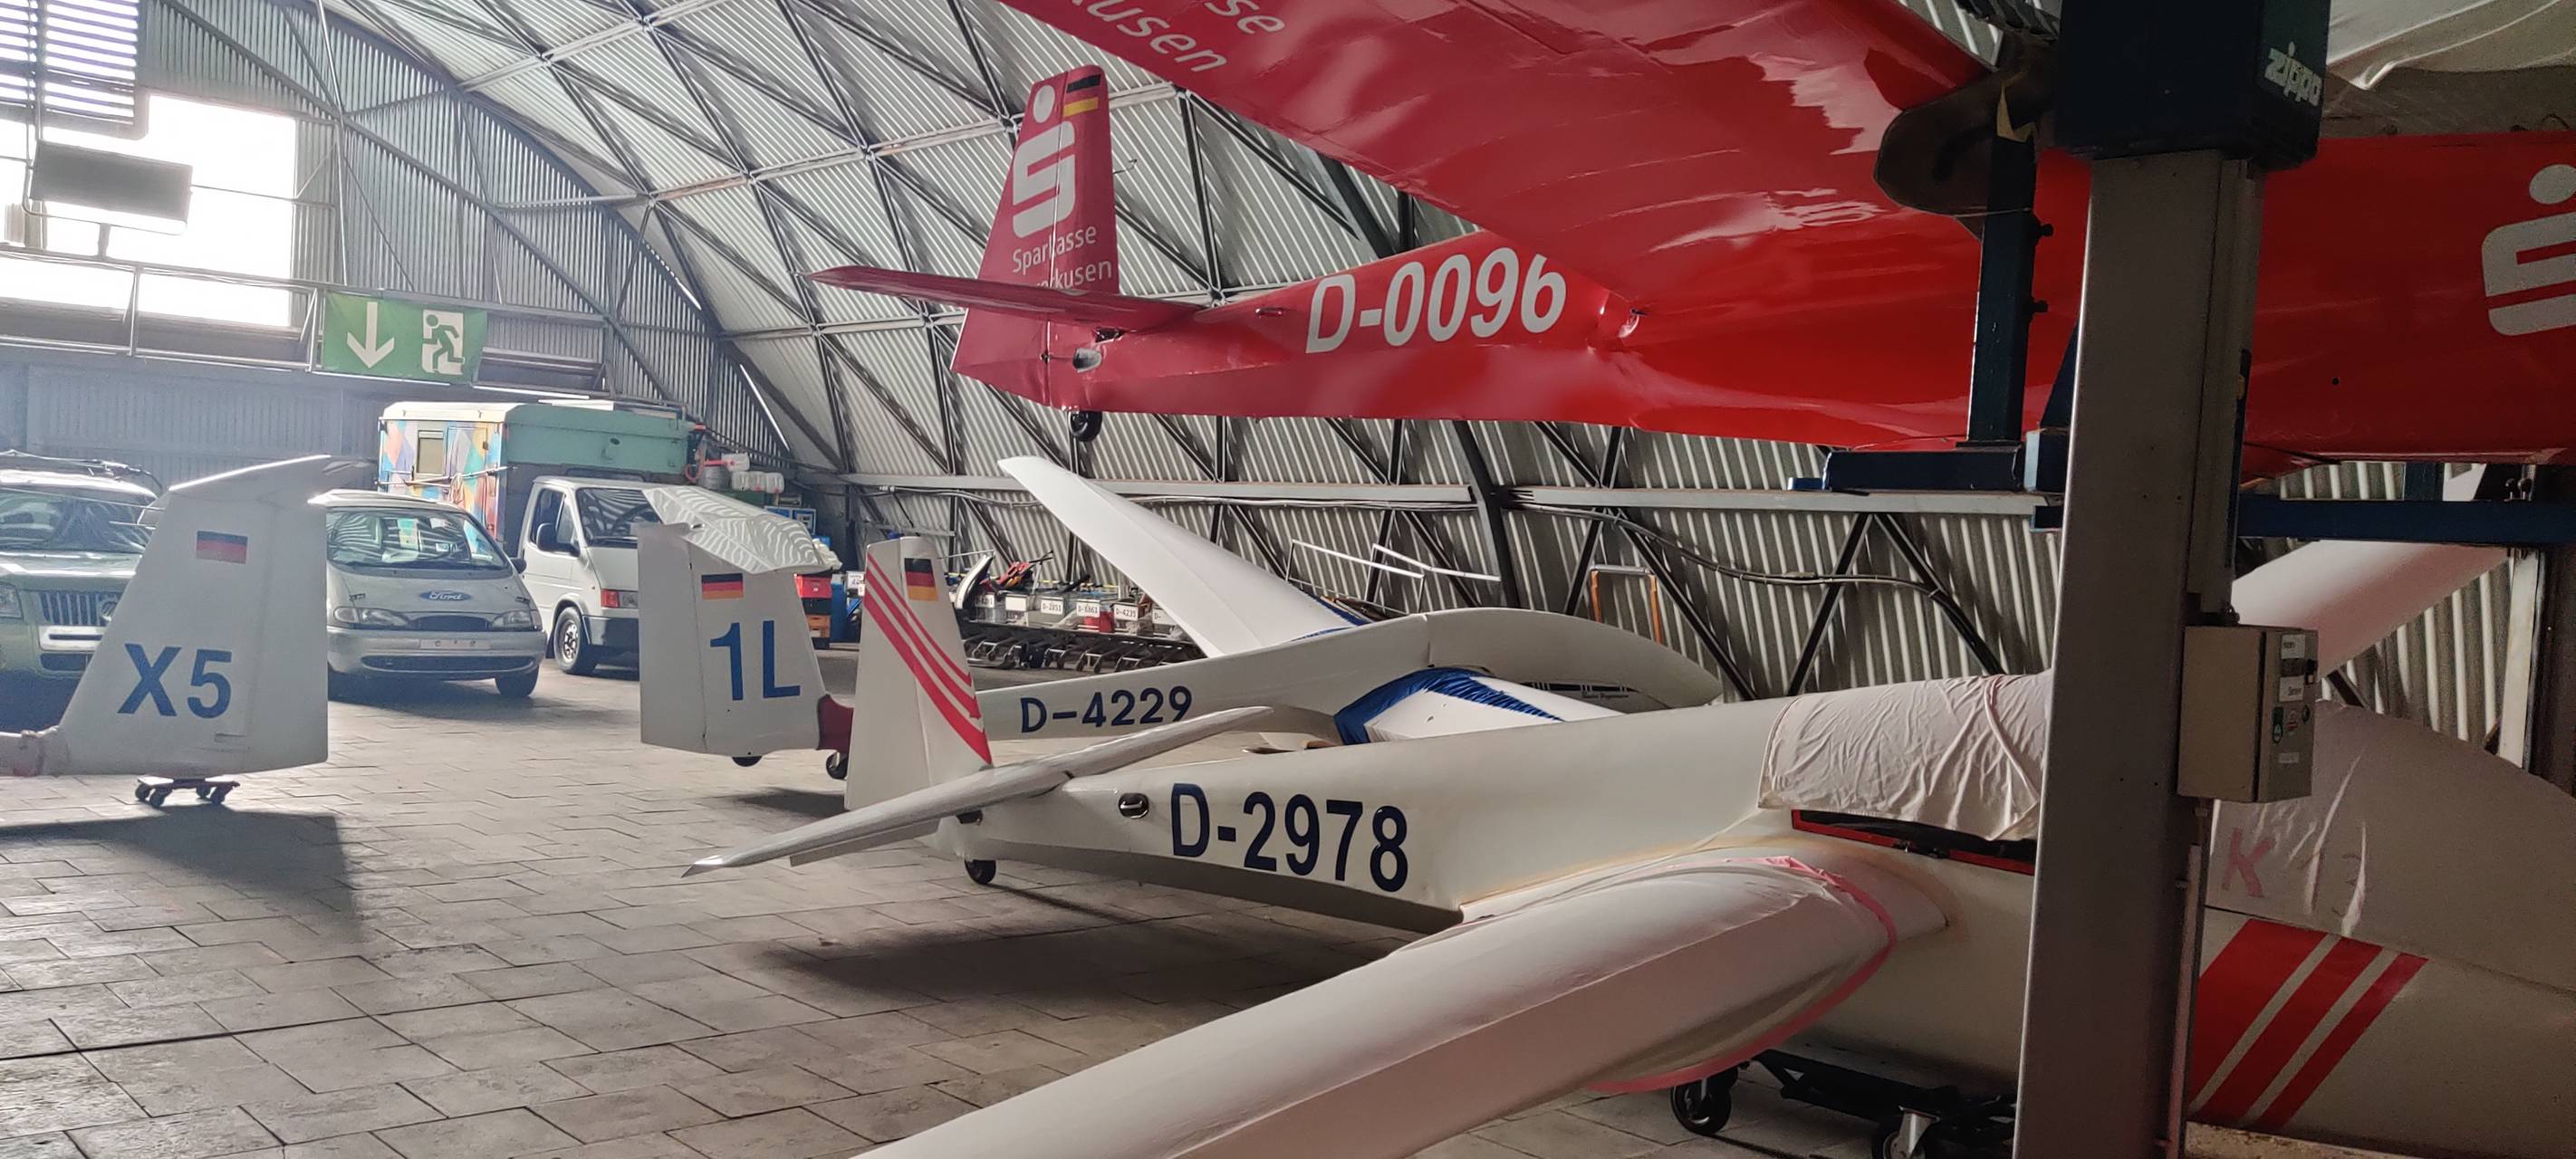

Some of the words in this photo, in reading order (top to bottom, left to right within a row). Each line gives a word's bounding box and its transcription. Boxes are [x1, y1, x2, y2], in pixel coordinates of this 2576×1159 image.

[1072, 0, 1227, 72] usen
[2264, 41, 2322, 107] zippo
[1036, 260, 1112, 289] kusen
[1305, 247, 1567, 354] D-0096
[429, 590, 464, 601] Ford
[117, 643, 233, 719] X5
[709, 619, 801, 701] 1L
[1020, 685, 1192, 733] D-4229
[1170, 783, 1408, 893] D-2978
